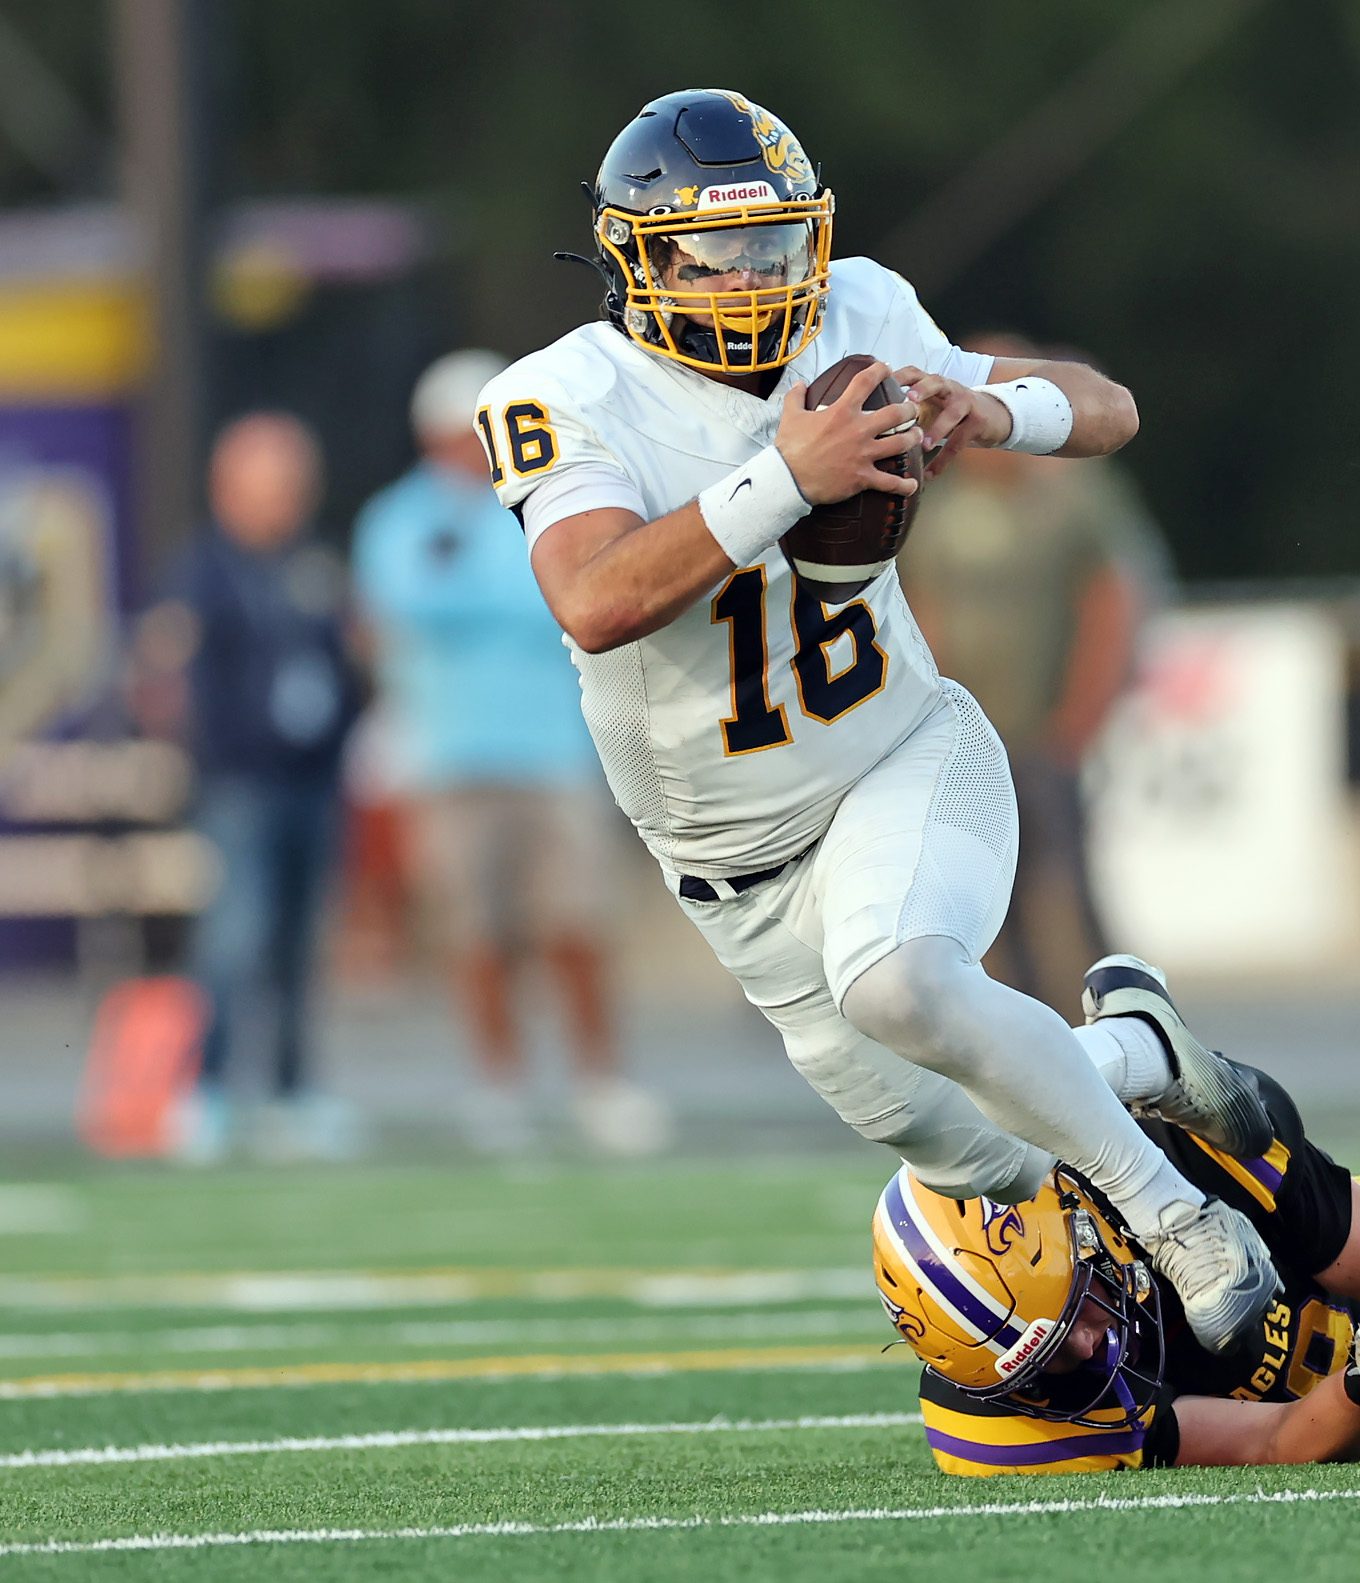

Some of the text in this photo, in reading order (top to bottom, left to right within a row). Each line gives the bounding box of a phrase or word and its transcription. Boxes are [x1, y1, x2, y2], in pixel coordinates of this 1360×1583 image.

[708, 185, 768, 203] Riddell
[727, 342, 753, 350] Ridde
[476, 398, 560, 490] 16
[711, 563, 889, 757] 16
[1000, 1325, 1048, 1373] Riddell
[1228, 1299, 1292, 1402] AGLES
